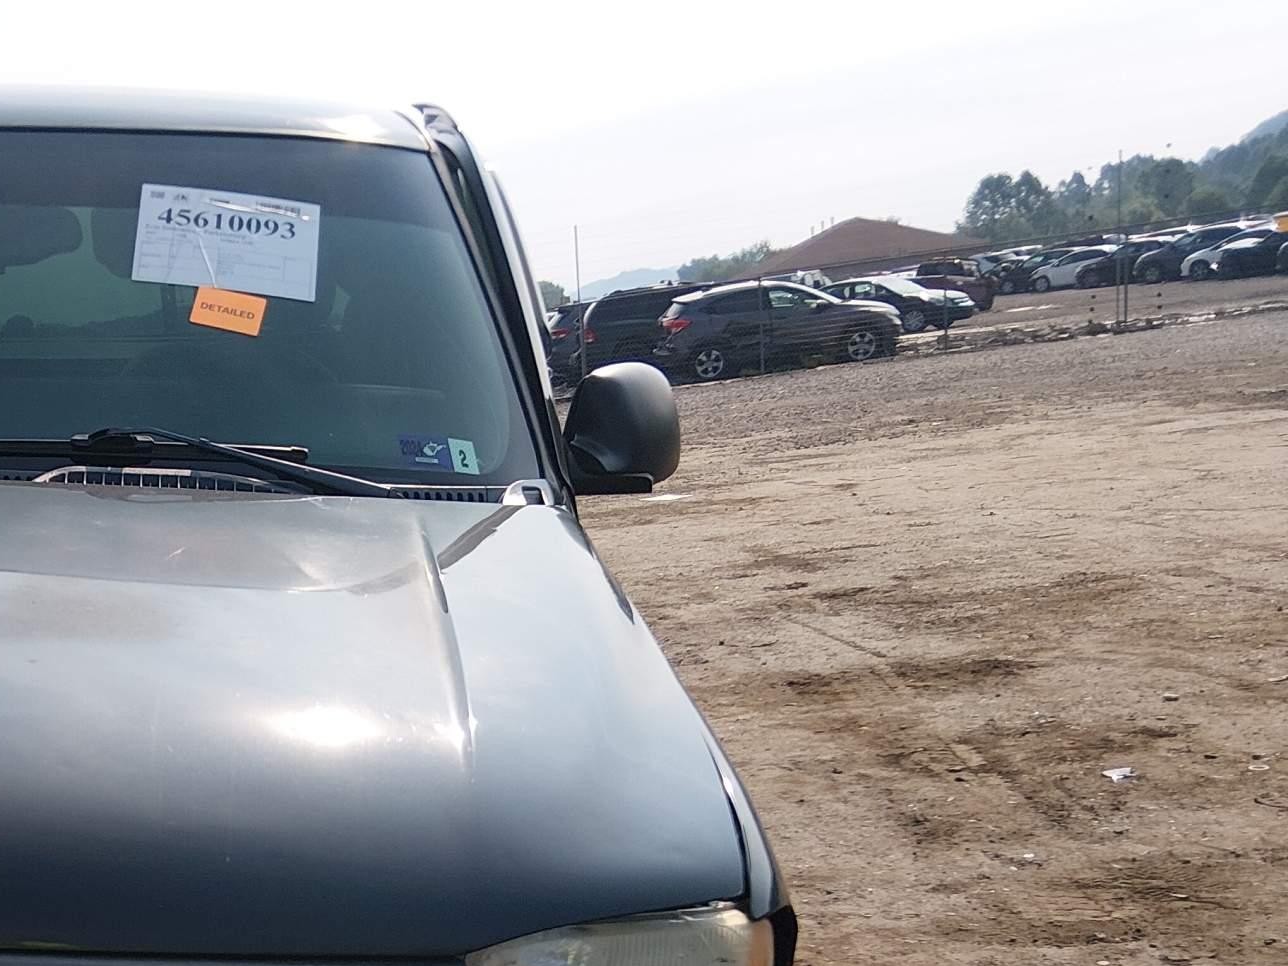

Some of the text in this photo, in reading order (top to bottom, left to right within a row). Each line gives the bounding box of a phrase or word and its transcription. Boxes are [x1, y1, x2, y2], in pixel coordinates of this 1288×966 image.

[157, 207, 296, 240] 45610093
[200, 301, 256, 320] DETAILED
[458, 449, 469, 468] 2
